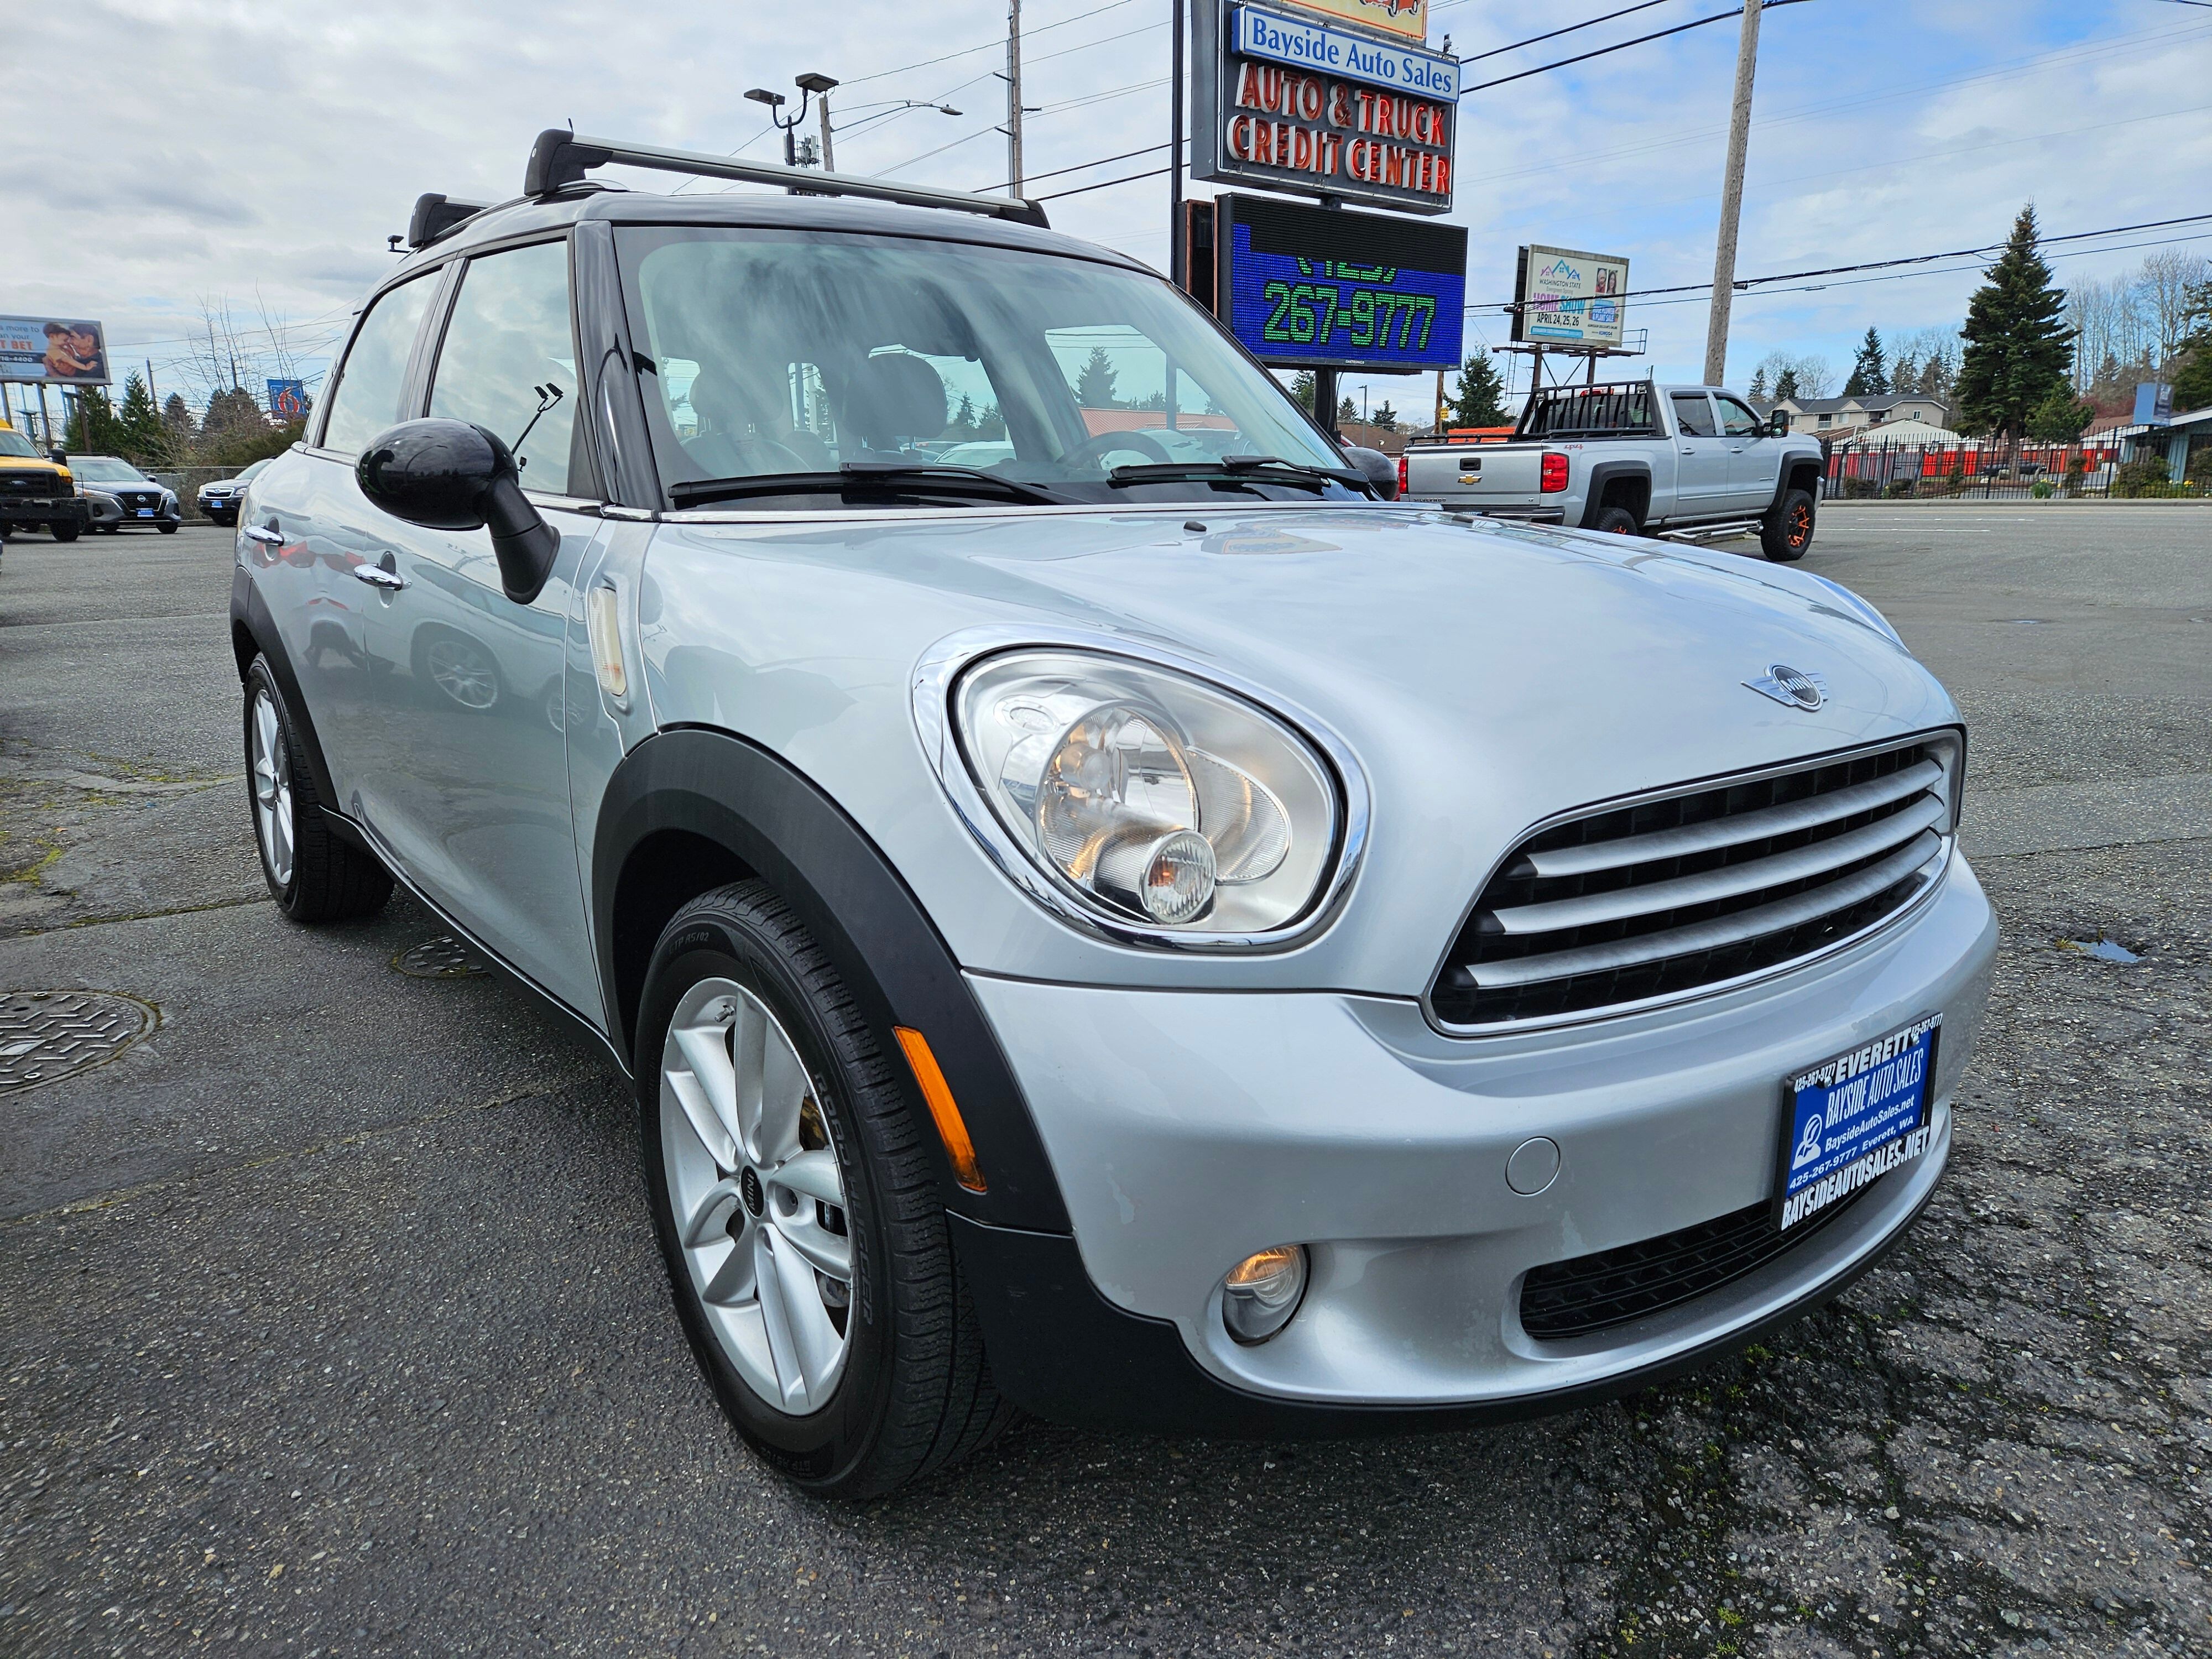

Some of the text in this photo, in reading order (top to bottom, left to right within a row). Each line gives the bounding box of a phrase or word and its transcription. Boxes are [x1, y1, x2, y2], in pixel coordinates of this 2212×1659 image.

[1253, 17, 1452, 93] Bayside Auto Sales
[1235, 62, 1447, 148] AUTO & TRUCK
[1227, 114, 1451, 195] CREDIT CENTER
[1264, 281, 1436, 349] 267-9777
[1533, 293, 1586, 314] HOME SHOW
[1540, 279, 1568, 287] WASHINGTON
[11, 340, 32, 350] BET
[1537, 313, 1579, 327] APRIL 24, 25, 26
[1780, 677, 1813, 691] MINI
[1794, 1026, 1912, 1093] 425-267-9777 EVERETT
[1910, 1013, 1943, 1039] 425-267-9777
[815, 1071, 852, 1166] ROAD
[1825, 1047, 1923, 1129] BAYSIDE AUTO SALES
[1789, 1114, 1914, 1190] 425-267-9777 Everett, WA
[1825, 1094, 1914, 1152] BaysideAutoSales.net
[747, 1172, 756, 1211] MINI
[1781, 1128, 1930, 1231] BAYSIDEAUTOSALES.NET
